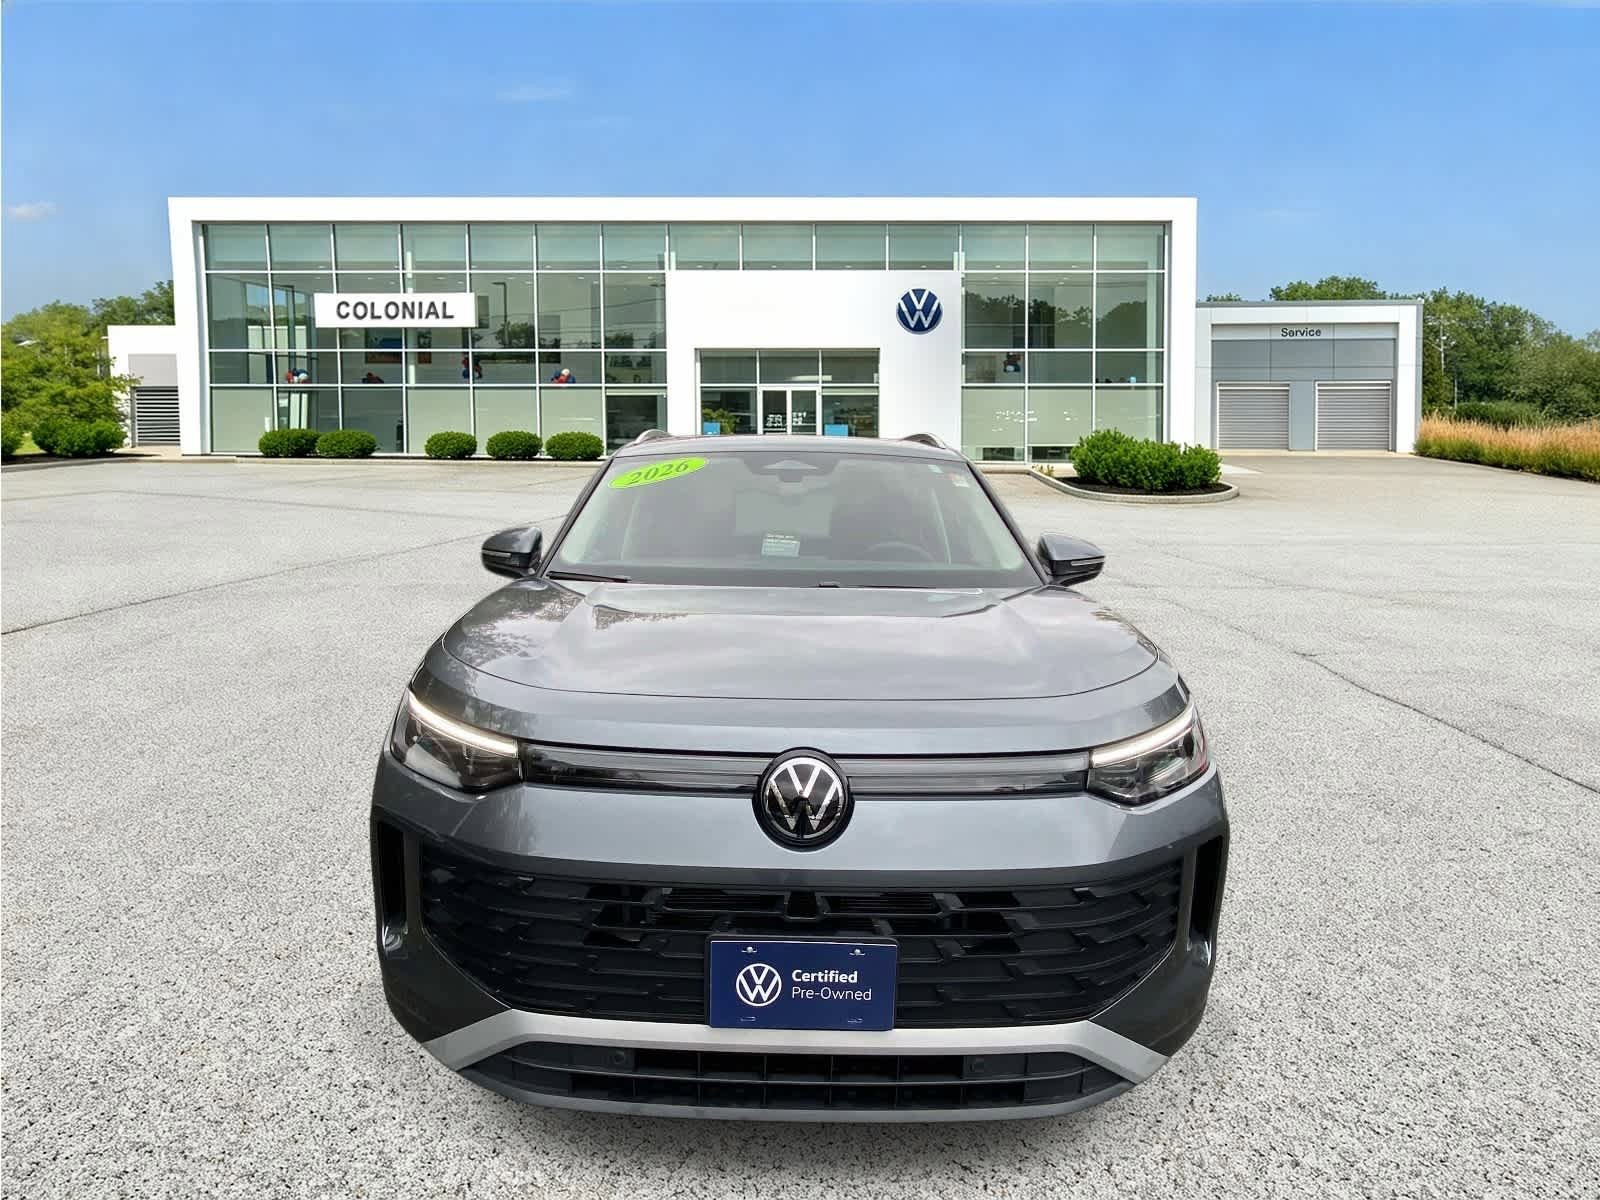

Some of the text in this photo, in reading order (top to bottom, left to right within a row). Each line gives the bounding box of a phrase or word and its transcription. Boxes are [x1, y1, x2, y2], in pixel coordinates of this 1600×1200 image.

[336, 301, 455, 320] COLONIAL
[898, 288, 941, 331] VW
[1281, 327, 1321, 338] Service
[627, 461, 689, 485] 2026
[767, 761, 841, 834] VW
[737, 965, 780, 1005] VW
[791, 969, 858, 983] Certified
[791, 986, 872, 1001] Pre-Owned
